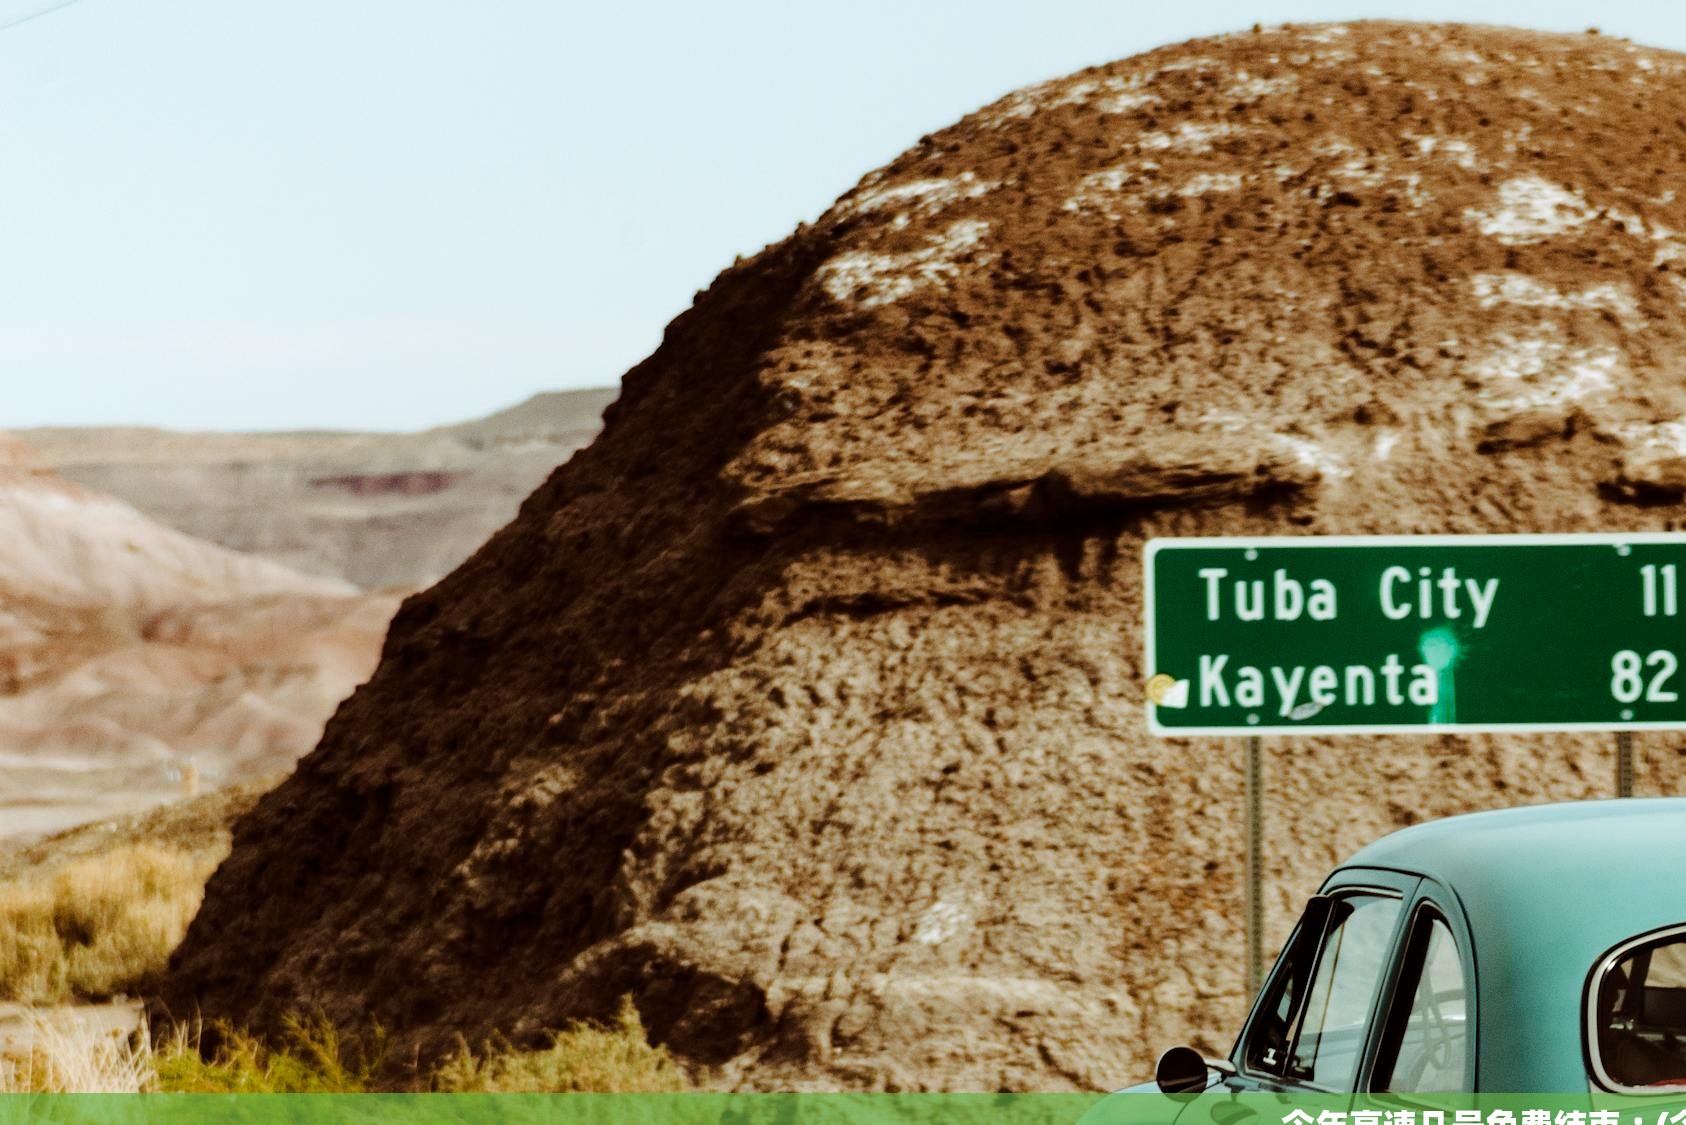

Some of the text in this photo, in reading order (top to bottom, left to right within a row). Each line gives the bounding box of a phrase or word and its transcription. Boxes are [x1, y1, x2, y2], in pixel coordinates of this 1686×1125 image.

[1198, 565, 1500, 629] Tuba City
[1640, 563, 1678, 617] 11
[1199, 653, 1440, 718] Kayenta
[1610, 649, 1679, 704] 82
